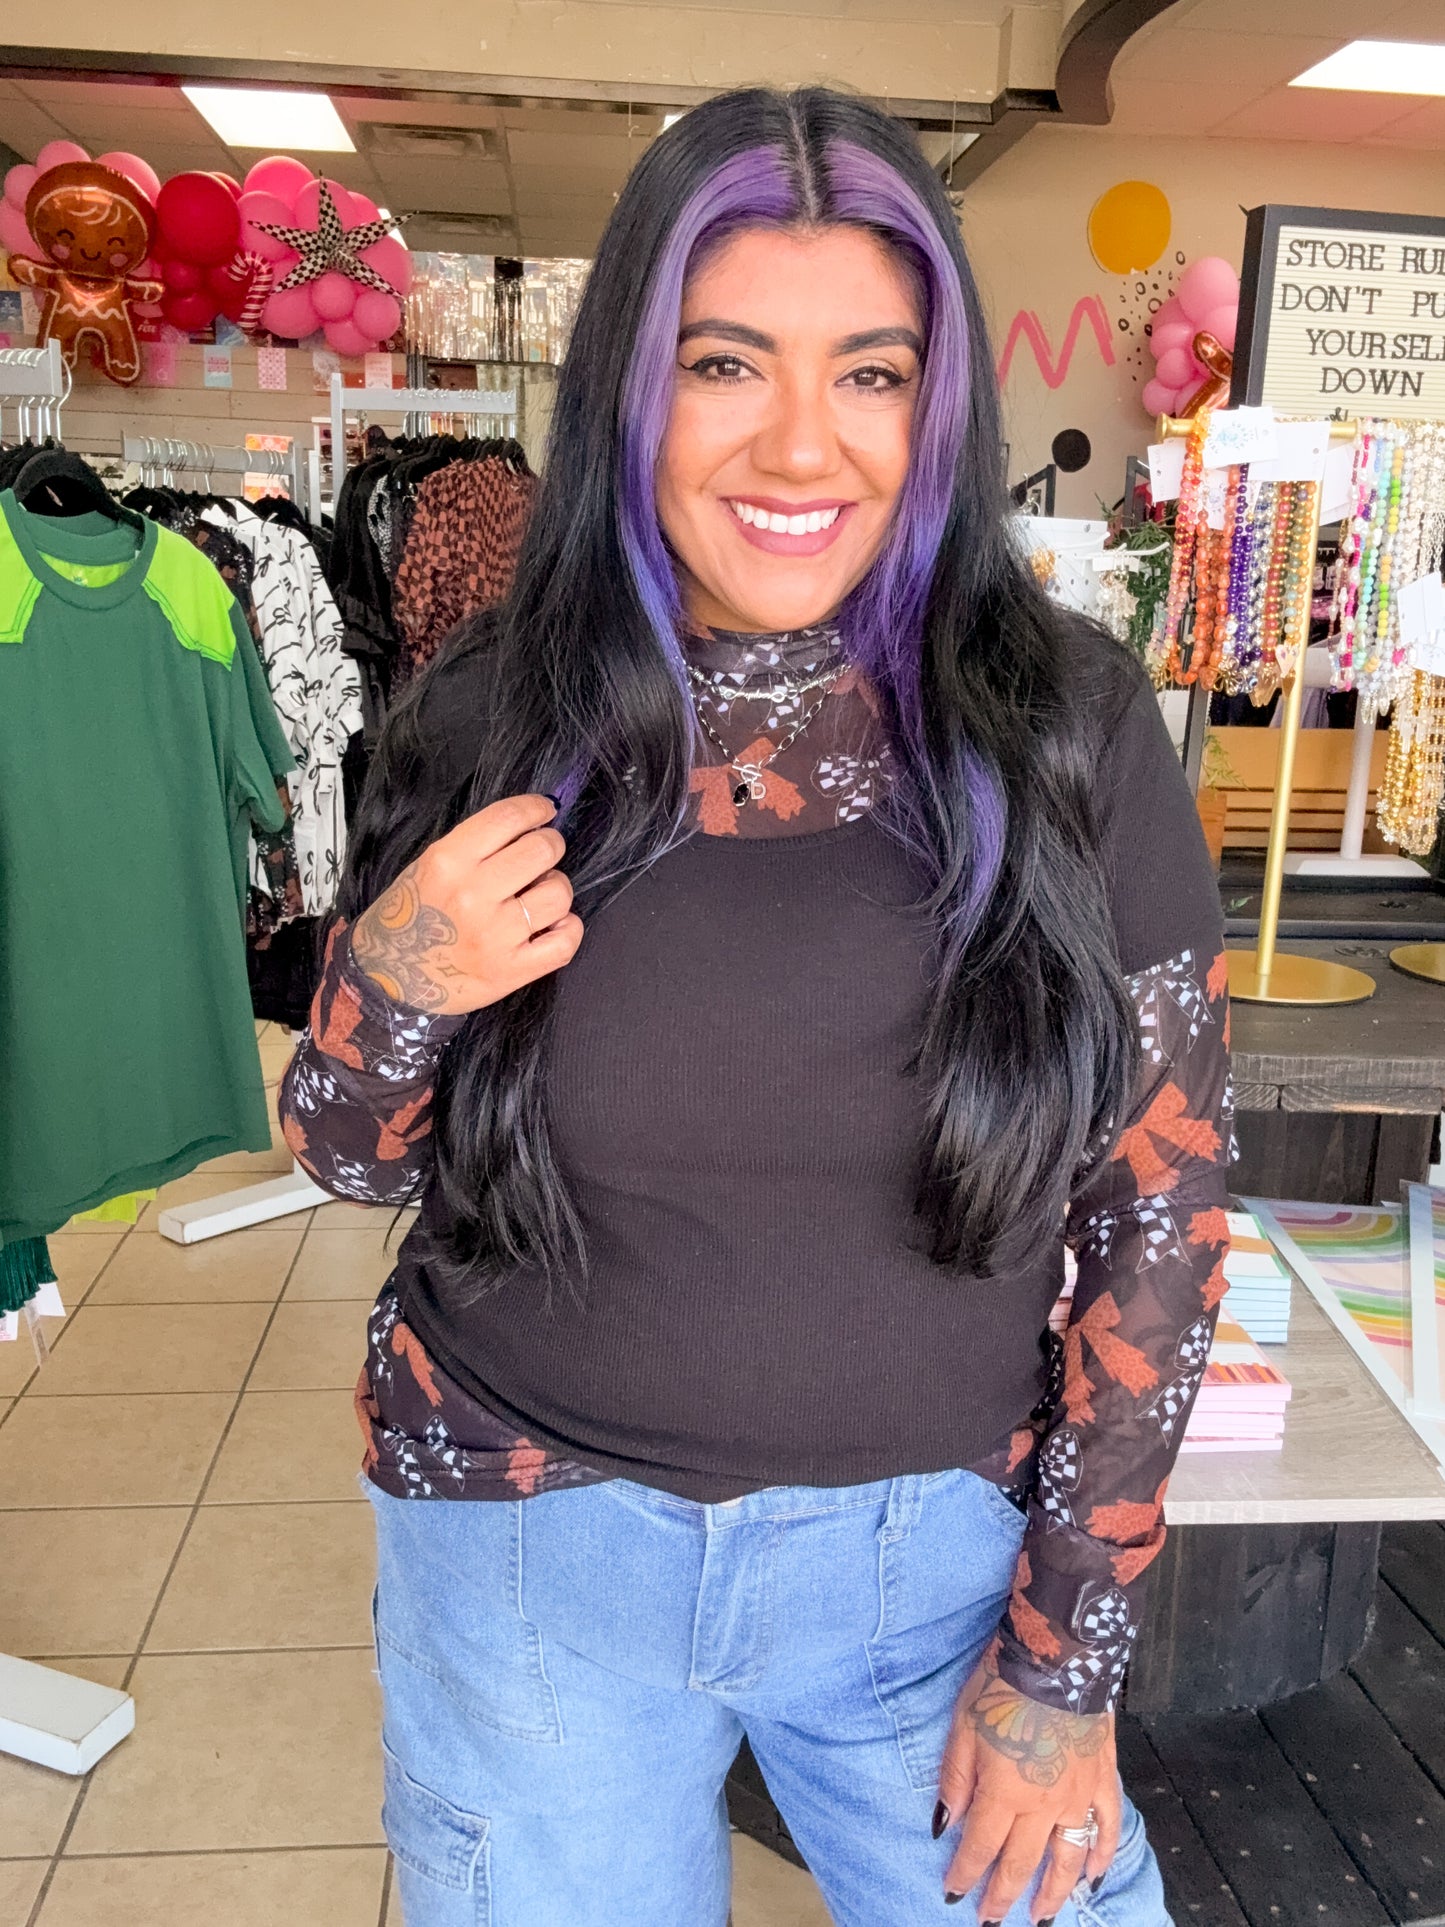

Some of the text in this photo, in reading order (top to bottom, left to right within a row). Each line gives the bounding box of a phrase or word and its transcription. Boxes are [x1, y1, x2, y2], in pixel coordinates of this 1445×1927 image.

[1287, 240, 1385, 271] STORE
[1279, 284, 1382, 315] DON'T
[1306, 329, 1445, 361] YOURSEL
[1320, 368, 1423, 397] DOWN
